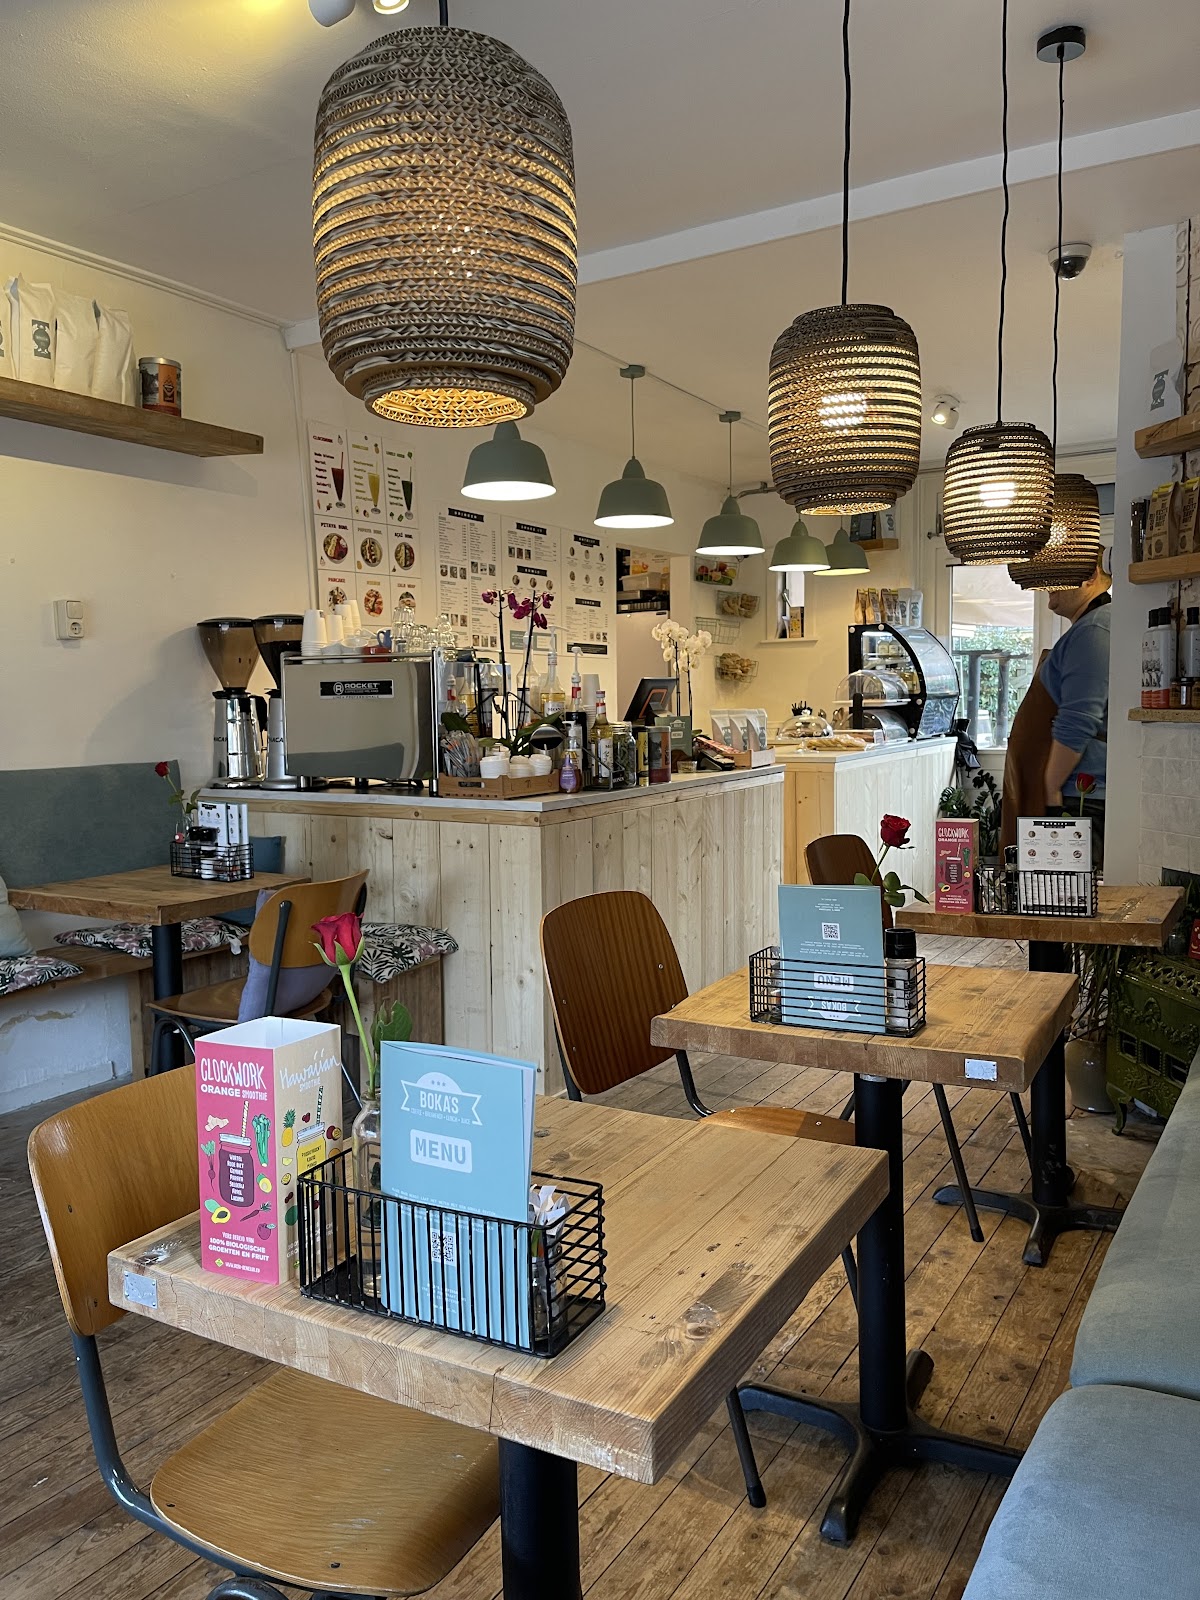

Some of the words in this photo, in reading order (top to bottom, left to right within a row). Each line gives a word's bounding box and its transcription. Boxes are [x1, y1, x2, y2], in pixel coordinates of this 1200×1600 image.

[937, 827, 970, 838] CLOCKWORK
[817, 975, 850, 987] MENU
[201, 1058, 266, 1090] CLOCKWORK
[201, 1084, 240, 1097] ORANGE
[242, 1090, 268, 1101] SMOOTHIE
[420, 1090, 459, 1114] BOKA'S
[415, 1137, 466, 1165] MENU
[208, 1244, 240, 1256] GROENTEN
[251, 1253, 269, 1262] FRUIT
[209, 1237, 225, 1246] 100%
[225, 1240, 266, 1253] BIOLOGISCHE
